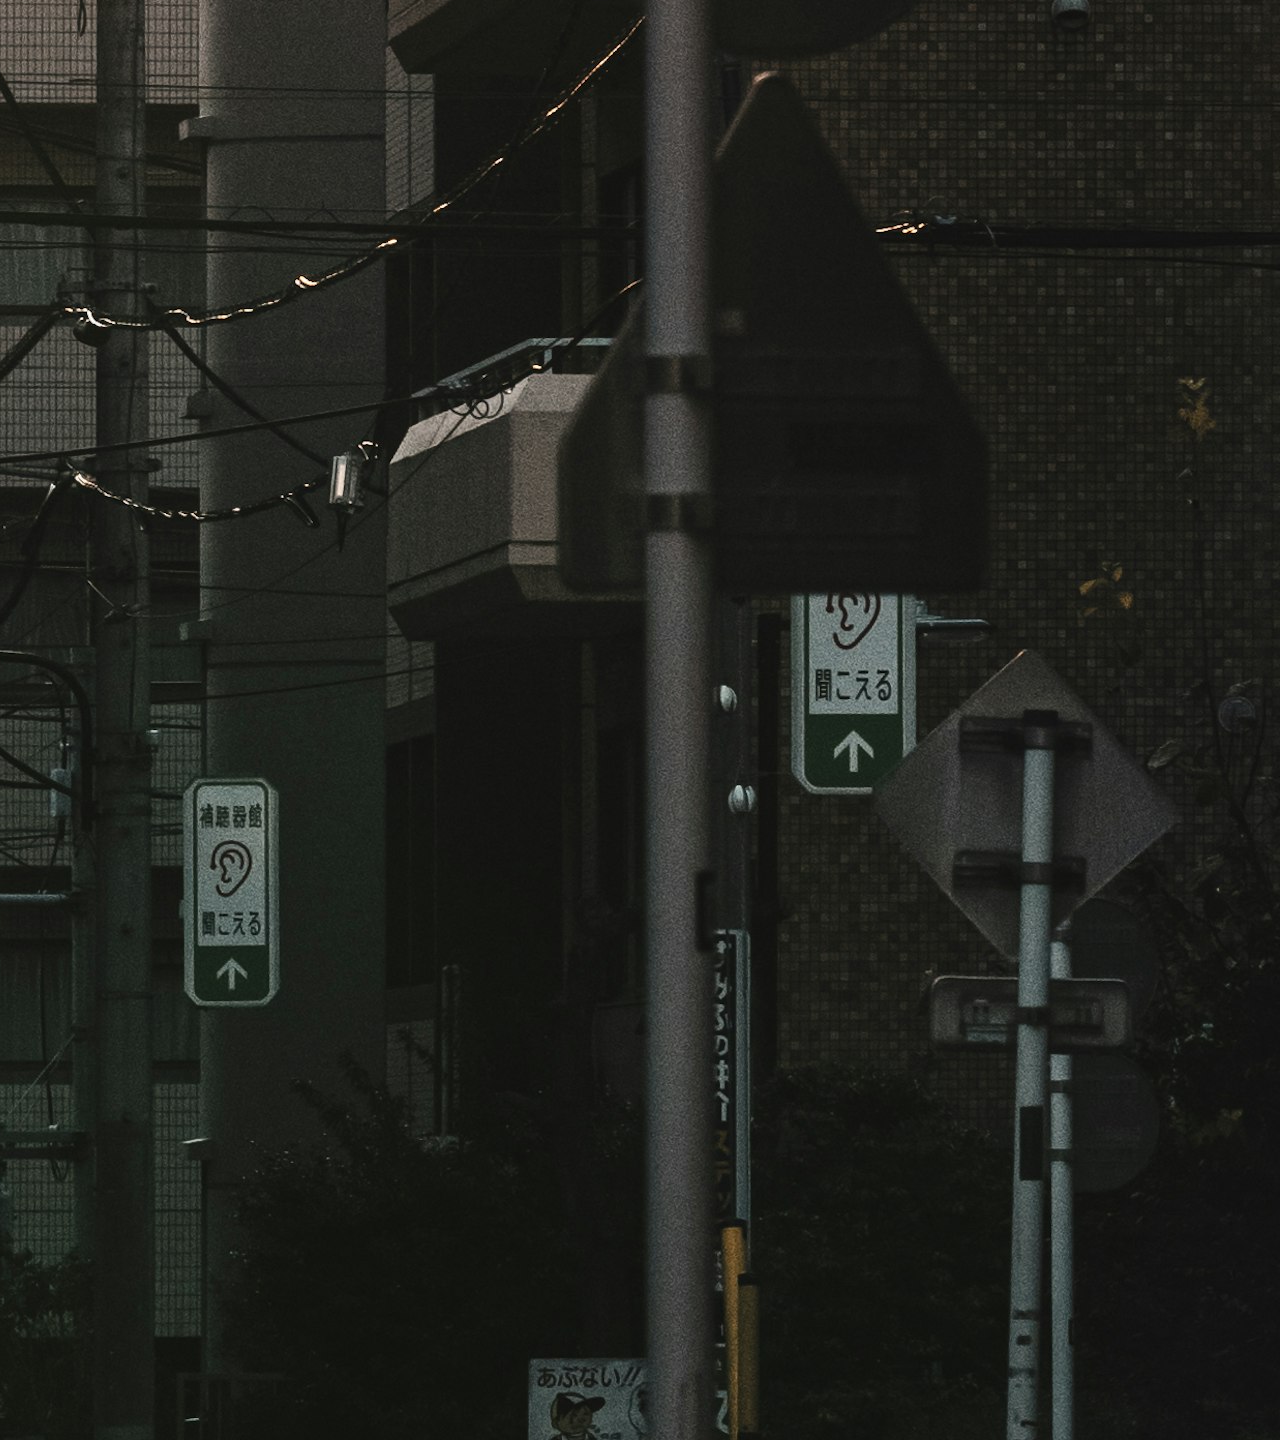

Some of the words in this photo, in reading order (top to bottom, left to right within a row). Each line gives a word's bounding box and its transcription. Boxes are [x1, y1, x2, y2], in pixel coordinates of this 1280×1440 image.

[815, 668, 892, 702] 聞こえる
[200, 803, 262, 829] 補聴器館
[202, 911, 262, 937] 聞こえる
